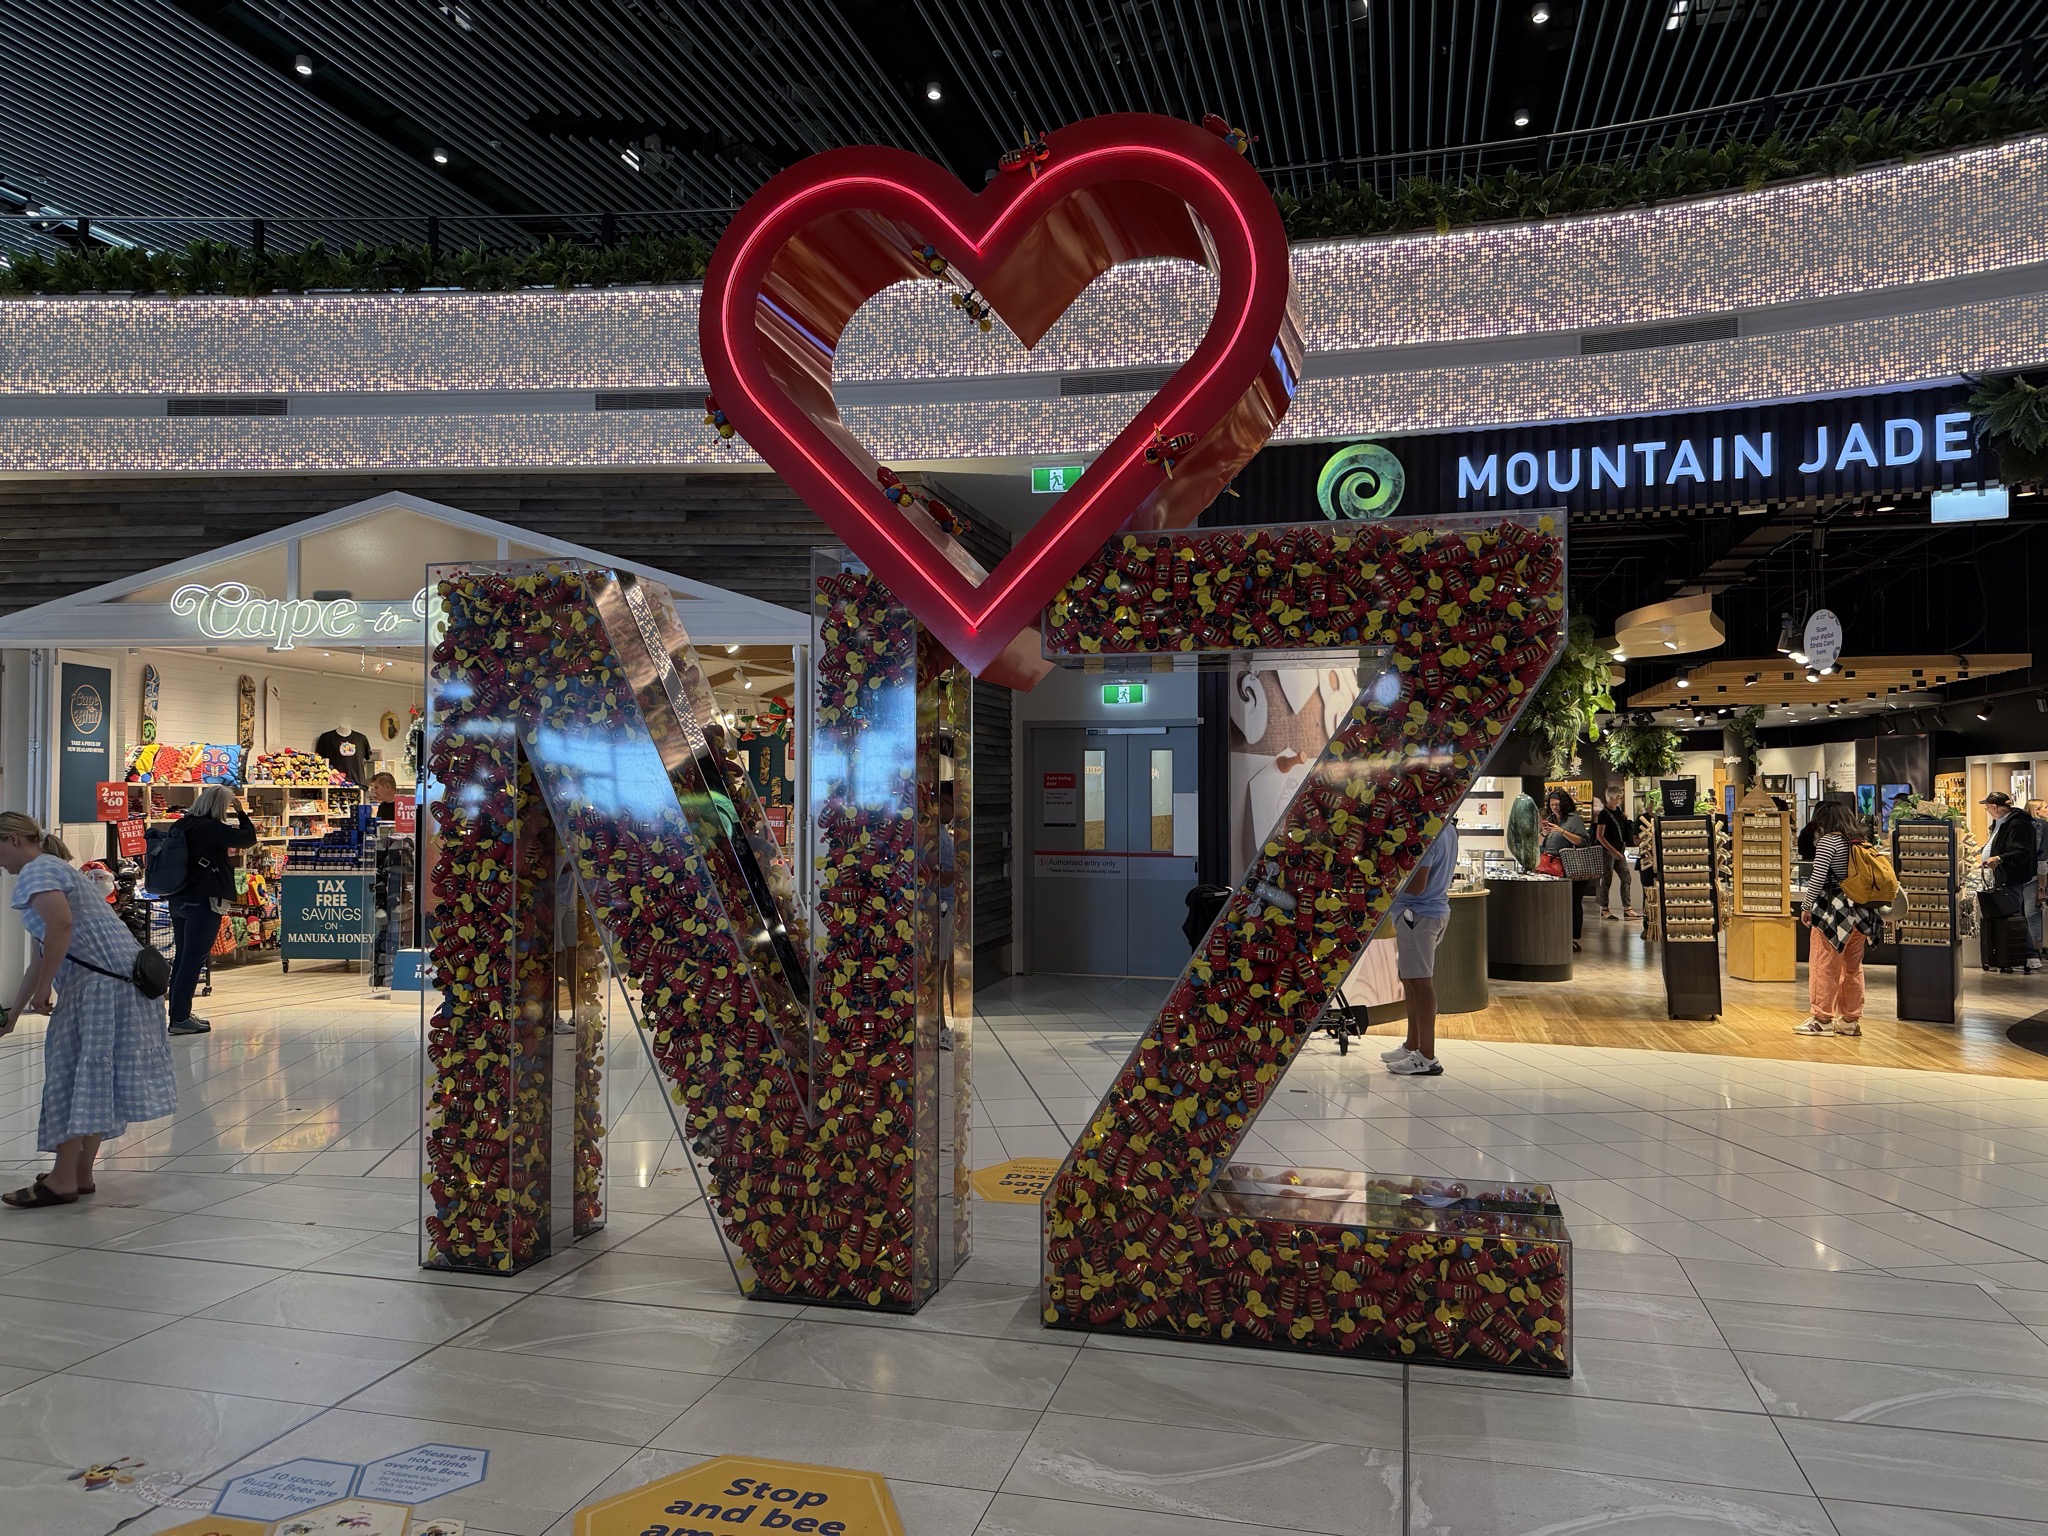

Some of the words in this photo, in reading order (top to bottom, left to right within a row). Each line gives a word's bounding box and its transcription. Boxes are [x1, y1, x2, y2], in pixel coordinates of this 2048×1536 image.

[1457, 431, 1773, 498] MOUNTAIN
[1798, 411, 1973, 474] JADE
[170, 582, 358, 650] Cape
[1820, 632, 1834, 640] digital
[101, 787, 109, 797] 2
[103, 797, 123, 806] $60
[397, 801, 404, 811] 2
[397, 811, 415, 820] $119
[122, 830, 144, 839] FREE
[1085, 860, 1100, 868] entry
[317, 880, 346, 892] TAX
[316, 894, 347, 907] FREE
[301, 907, 362, 921] SAVINGS
[288, 933, 334, 943] MANUKA
[337, 933, 375, 943] HONEY
[418, 1449, 458, 1460] Please
[459, 1454, 476, 1462] do
[408, 1456, 430, 1464] not
[432, 1459, 467, 1469] climb
[384, 1462, 413, 1470] over
[415, 1463, 437, 1473] the
[438, 1467, 470, 1478] Bees.
[270, 1472, 286, 1480] 10
[288, 1475, 336, 1488] special
[379, 1480, 397, 1488] This
[391, 1477, 438, 1487] supervised
[420, 1474, 451, 1483] should
[242, 1477, 281, 1490] Buzzy
[283, 1484, 314, 1494] Bees
[315, 1489, 338, 1498] are
[238, 1486, 283, 1500] hidden
[285, 1494, 316, 1504] here
[723, 1478, 828, 1510] Stop
[664, 1500, 758, 1524] and
[759, 1508, 846, 1536] bee
